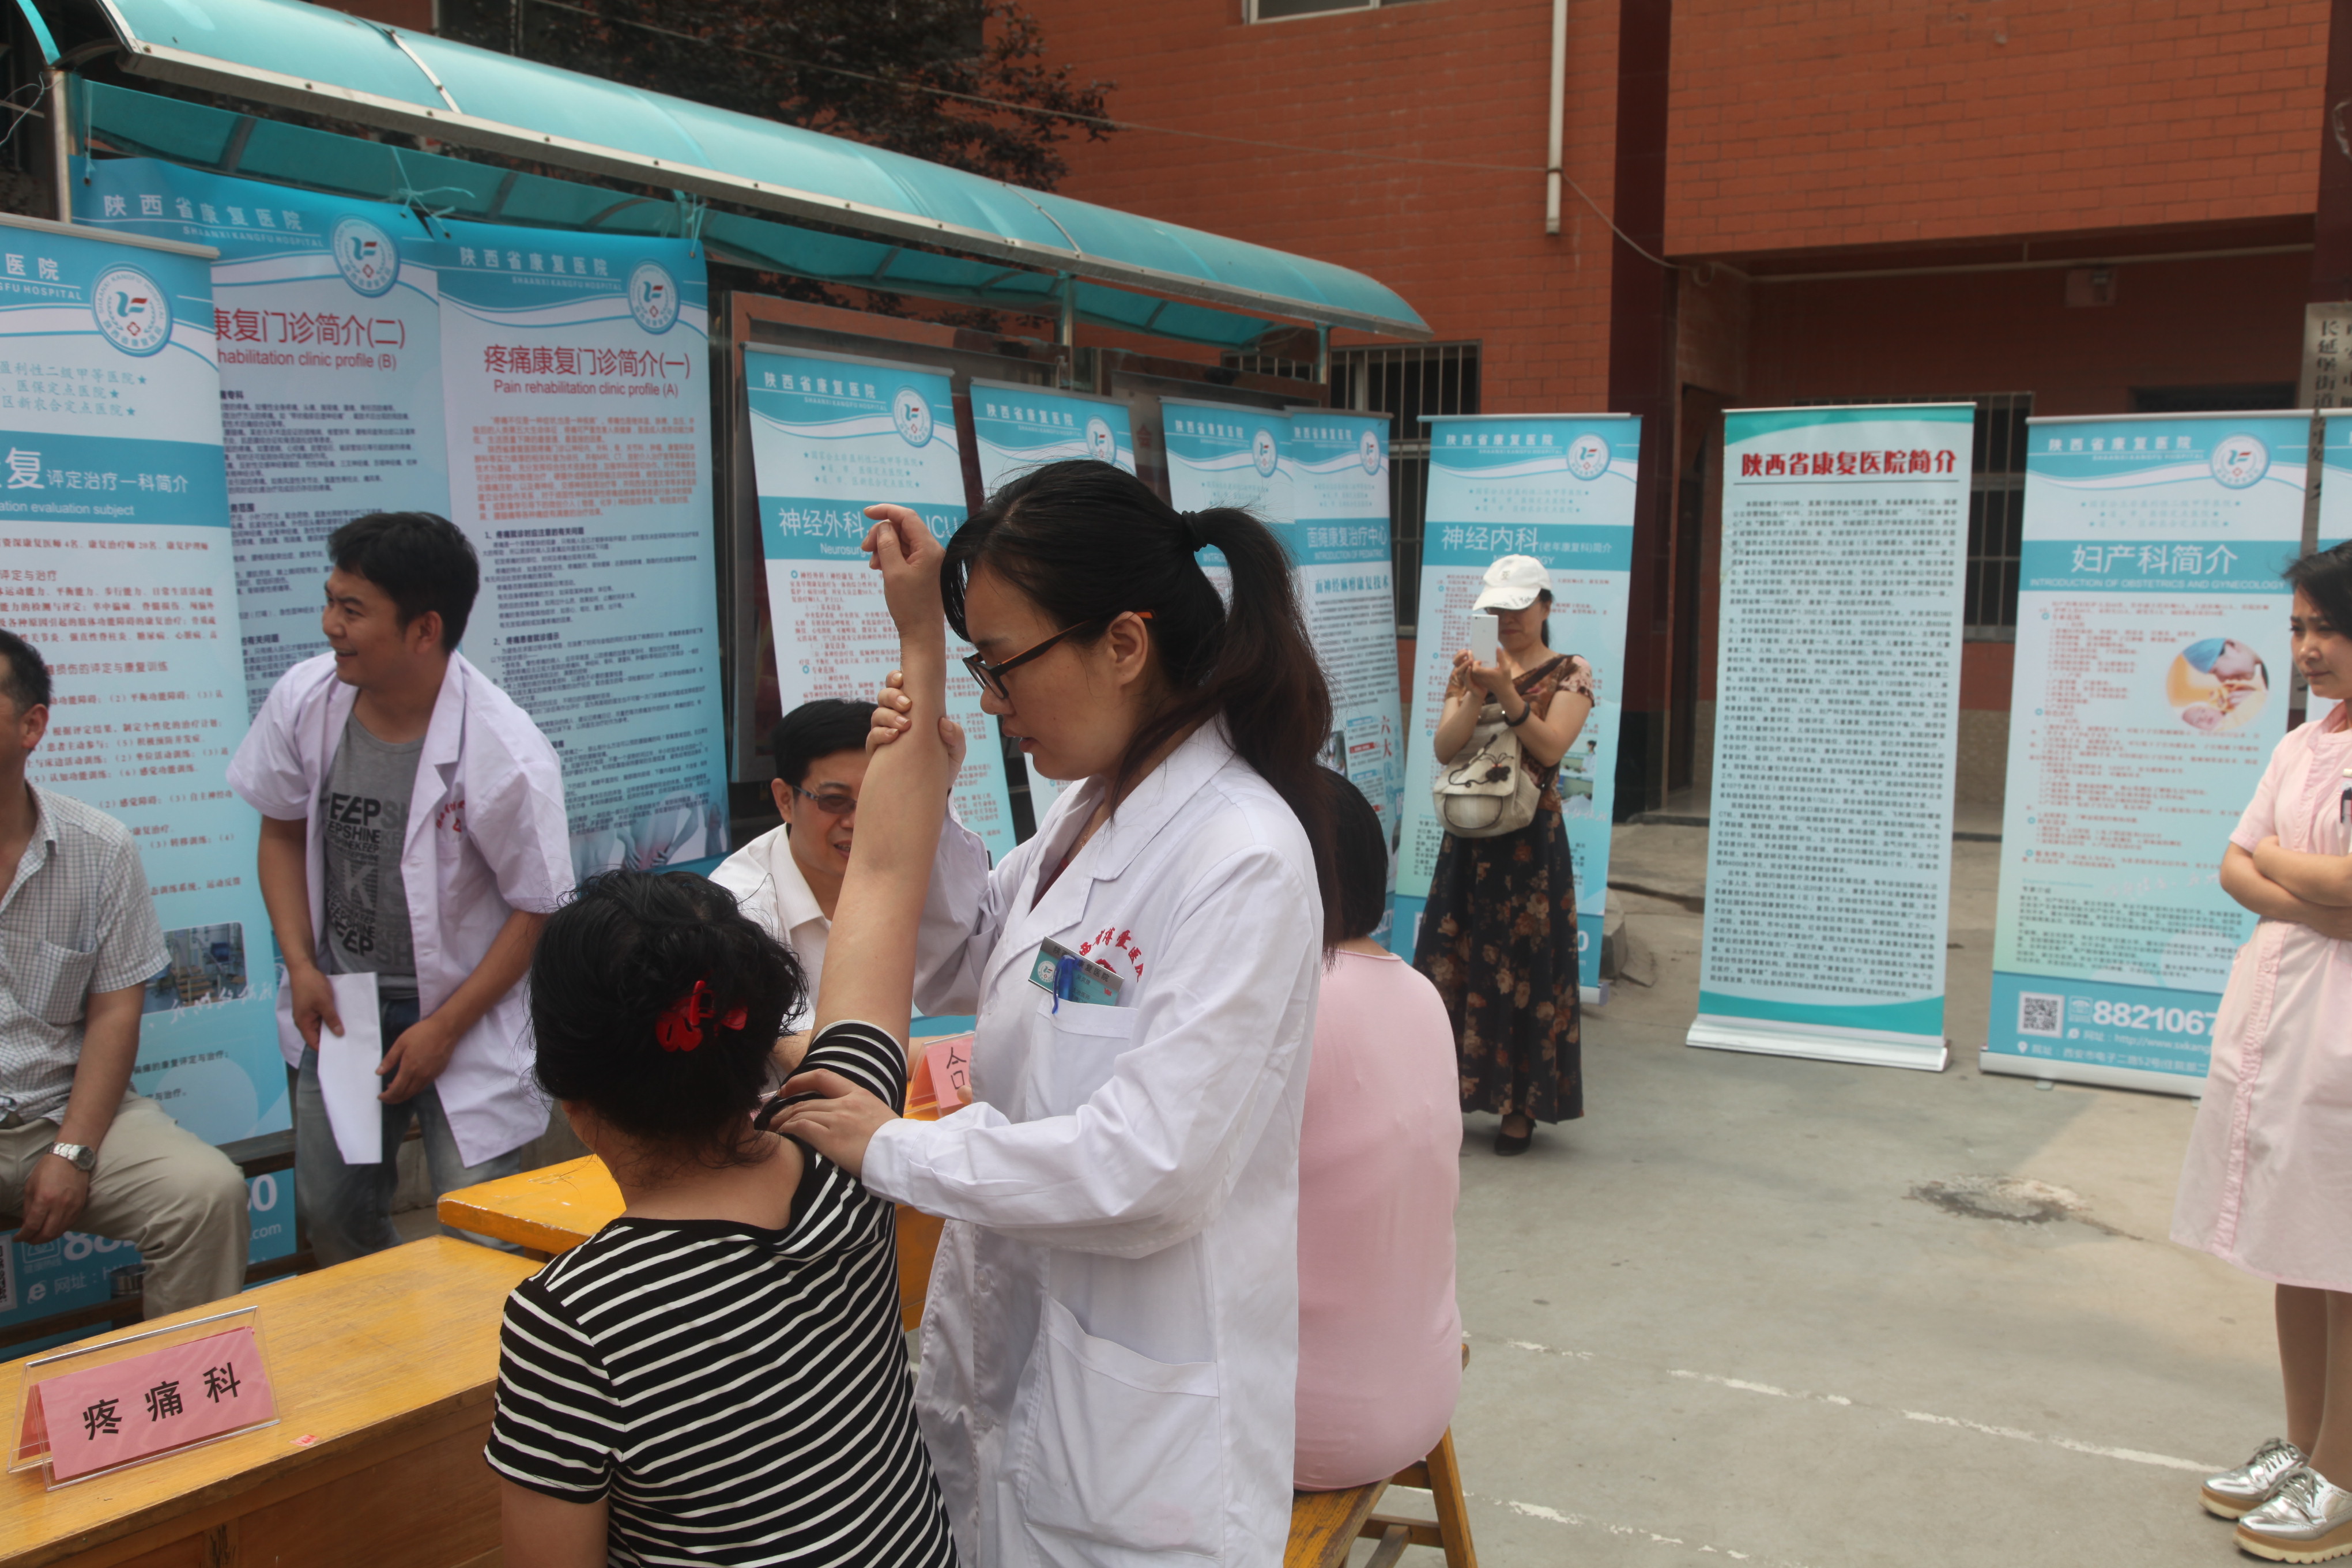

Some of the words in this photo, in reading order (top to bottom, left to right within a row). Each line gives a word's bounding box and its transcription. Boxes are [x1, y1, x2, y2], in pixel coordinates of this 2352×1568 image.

[104, 194, 303, 231] 陕西省康复医院
[232, 231, 274, 243] KANGFU
[276, 235, 323, 247] HOSPITAL
[5, 253, 60, 281] 医院
[459, 247, 609, 276] 陕西省康复医院
[23, 285, 83, 301] HOSPITAL
[214, 307, 406, 349] 康复门诊简介(二)
[298, 351, 332, 367] clinic
[336, 353, 374, 370] profile
[378, 353, 397, 371] (B)
[483, 344, 691, 380] 疼痛康复门诊简介(一)
[493, 378, 521, 394] Pain
[525, 380, 597, 395] rehabilitation
[598, 382, 626, 395] clinic
[628, 383, 660, 398] profile
[662, 383, 679, 399] (A)
[764, 371, 876, 399] 陕西省康复医院
[986, 403, 1074, 427] 陕西省康复医院
[1446, 434, 1554, 446] 陕西省康复医院
[2048, 436, 2192, 452] 陕西省康复医院
[1740, 449, 1957, 477] 陕西省康复医院简介
[31, 502, 91, 515] evaluation
[93, 504, 135, 518] subject
[1442, 525, 1539, 553] 神经内科
[2071, 544, 2239, 575] 妇产科简介
[2030, 577, 2104, 588] INTRODUCTION
[2105, 579, 2119, 588] OF
[2121, 578, 2185, 589] OBSTETRICS
[2187, 579, 2210, 590] AND
[2211, 579, 2286, 590] GYNECOLOGY
[1052, 945, 1110, 982] 陕西康复医院
[82, 1361, 241, 1441] 疼痛科
